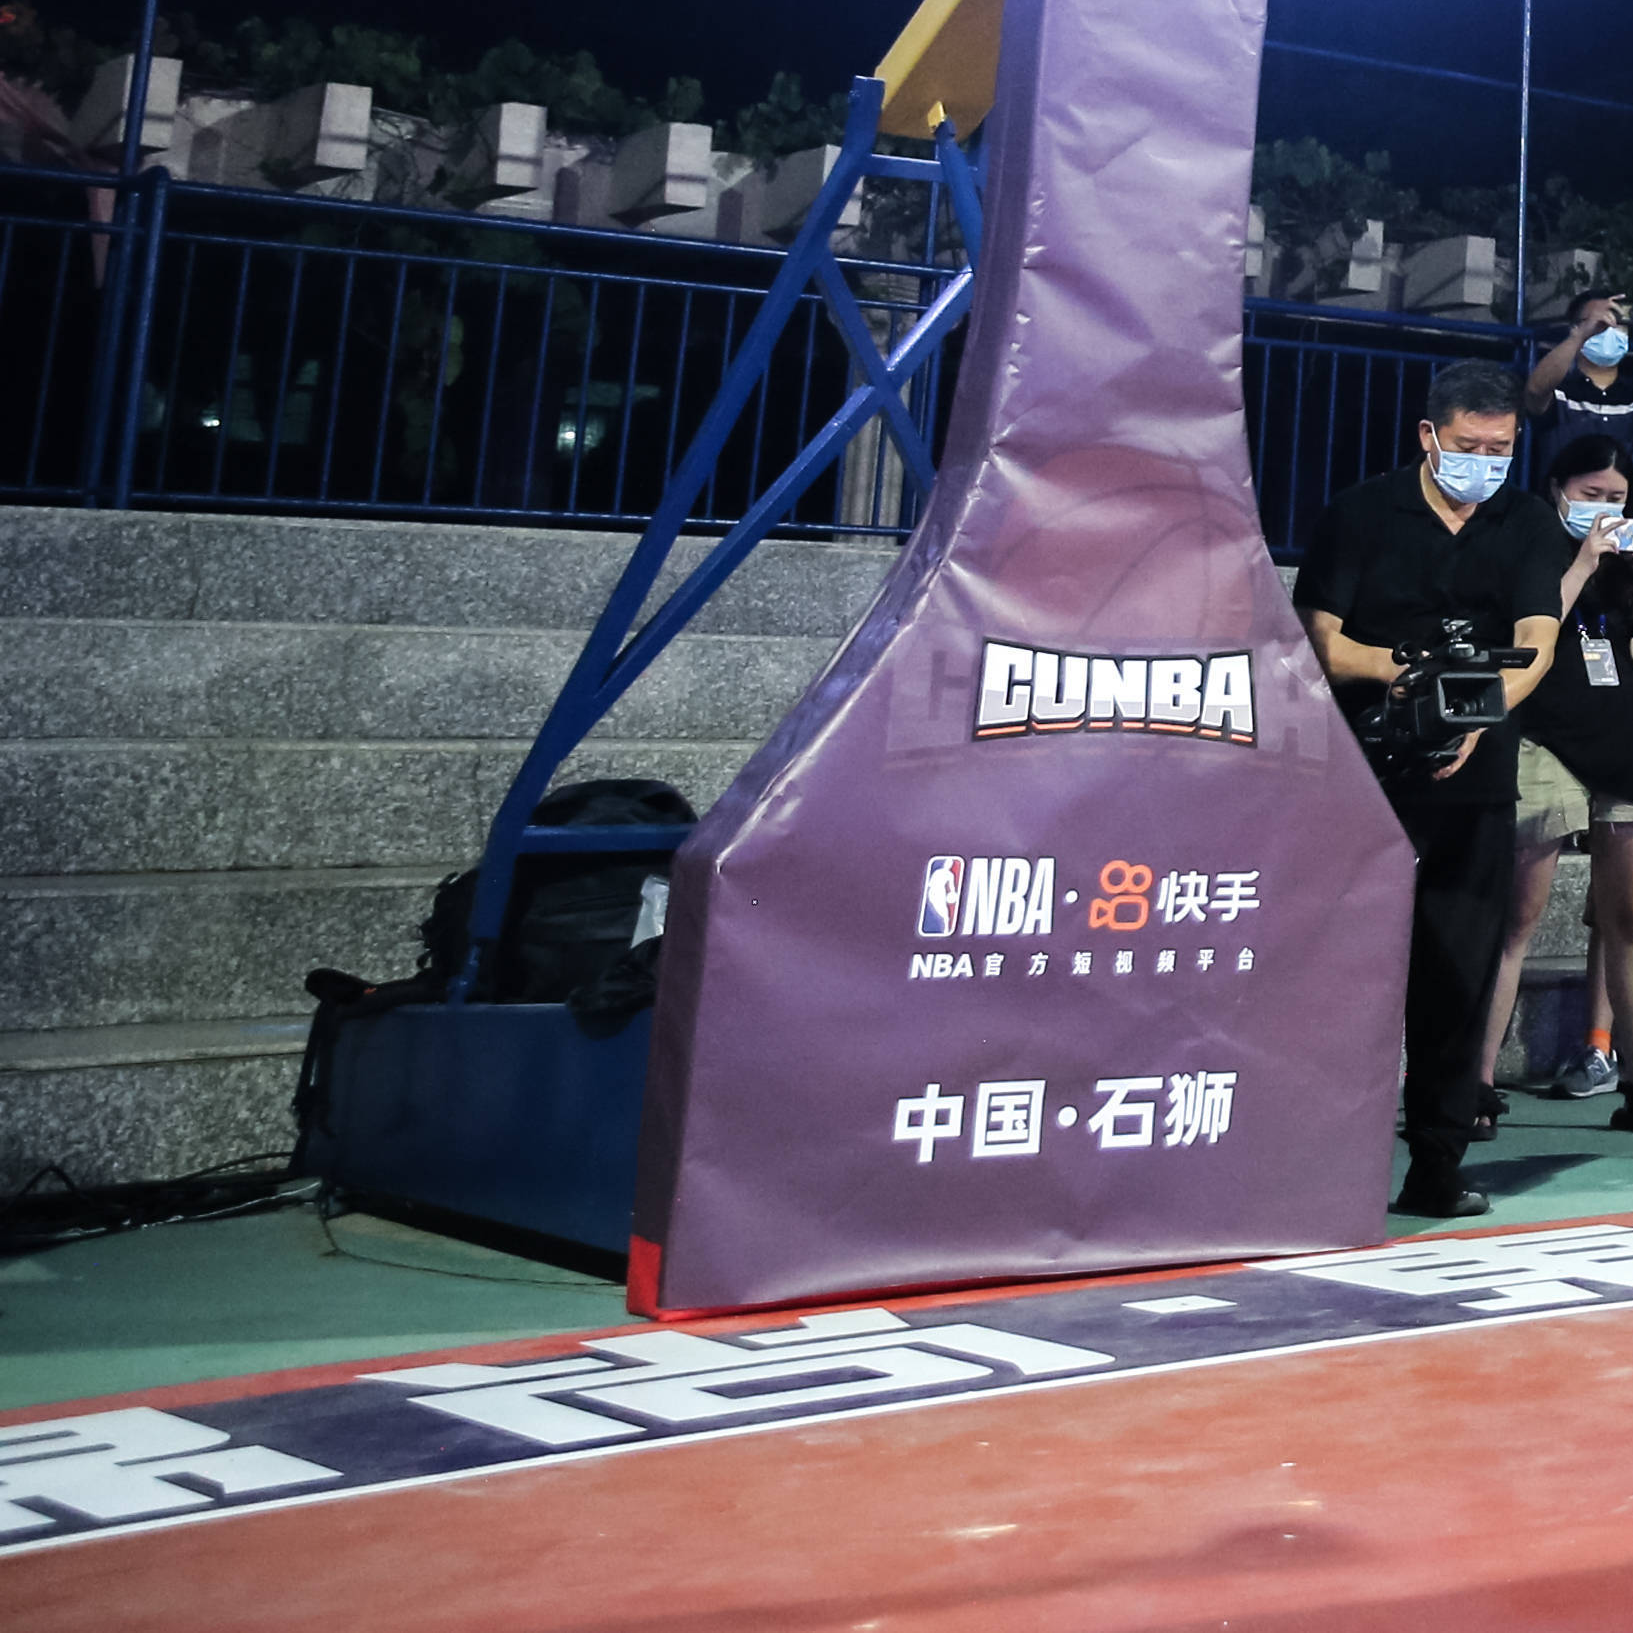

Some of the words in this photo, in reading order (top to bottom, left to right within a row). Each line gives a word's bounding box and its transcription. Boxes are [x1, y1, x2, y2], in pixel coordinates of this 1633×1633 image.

[977, 642, 1254, 733] CUNBA
[963, 857, 1055, 936] NBA
[1157, 870, 1260, 923] 快手
[893, 1070, 1239, 1164] 中国·石狮
